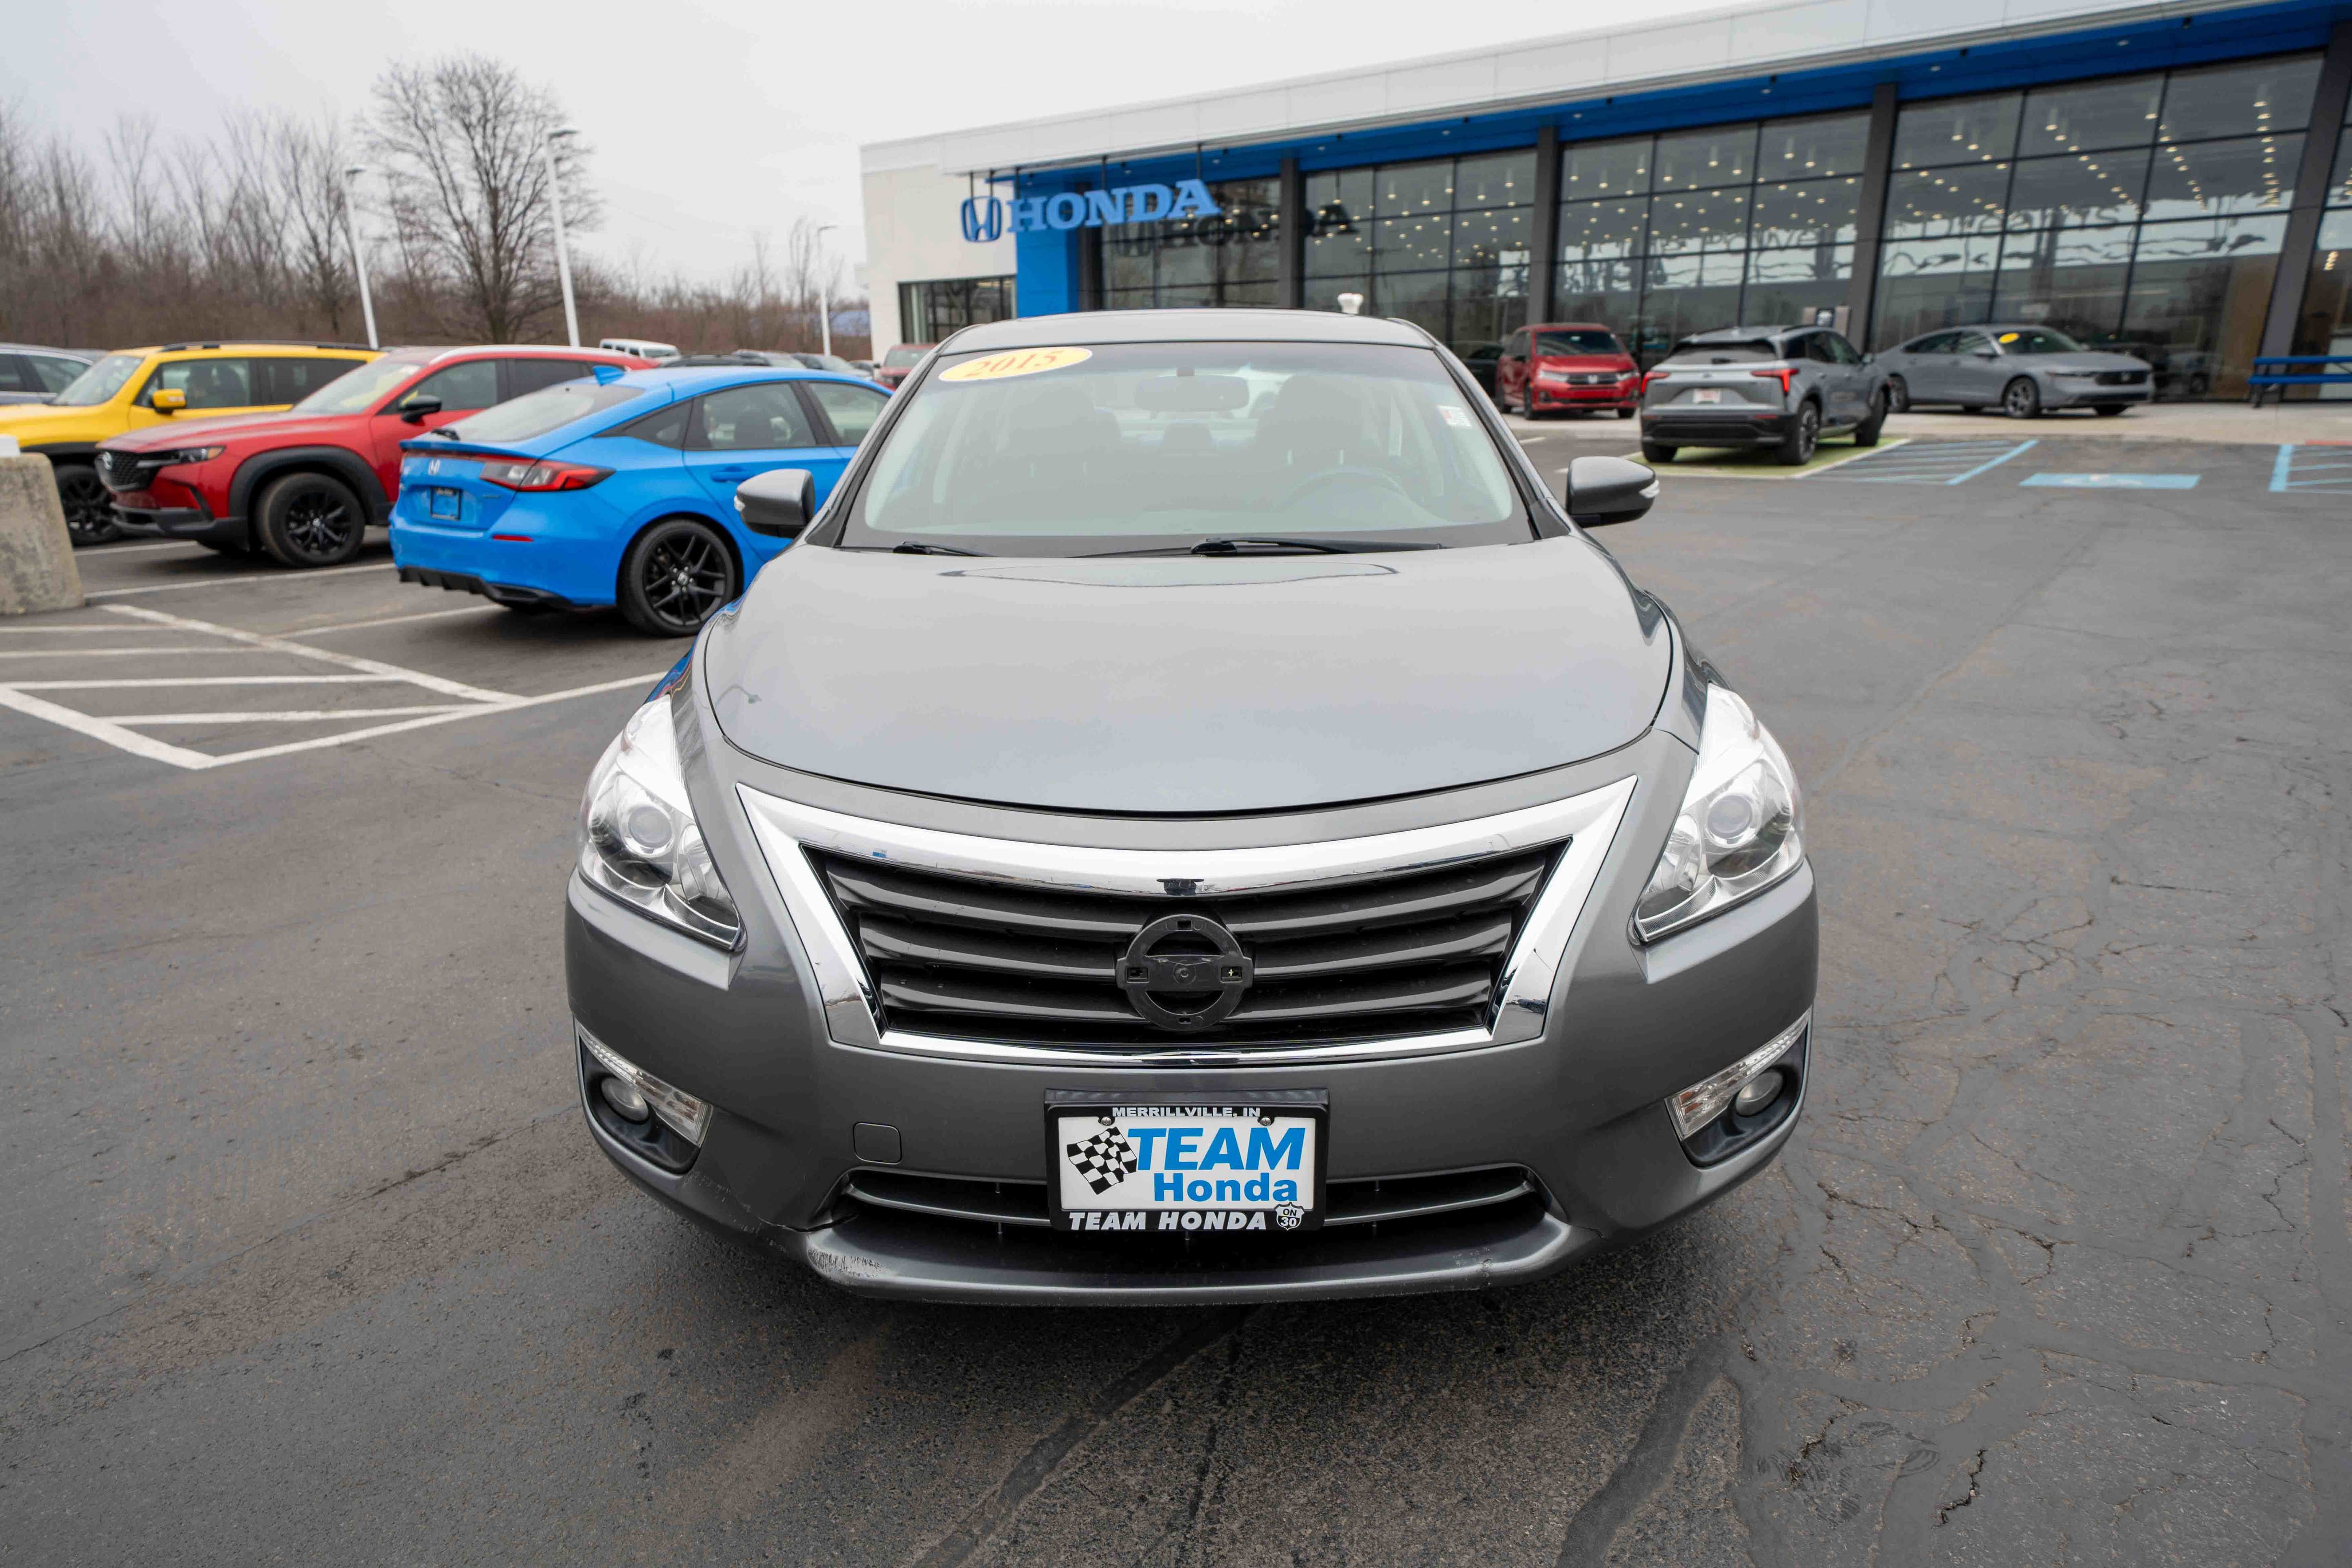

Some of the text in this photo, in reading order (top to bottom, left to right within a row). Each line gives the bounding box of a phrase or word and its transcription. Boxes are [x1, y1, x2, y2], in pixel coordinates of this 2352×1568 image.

[1007, 178, 1222, 233] HONDA
[964, 350, 1064, 377] 2015
[1112, 1107, 1260, 1118] MERRILLVILLE, IN
[1127, 1127, 1305, 1170] TEAM
[1154, 1173, 1297, 1201] Honda
[1069, 1212, 1266, 1230] TEAM HONDA
[1281, 1217, 1297, 1227] 30
